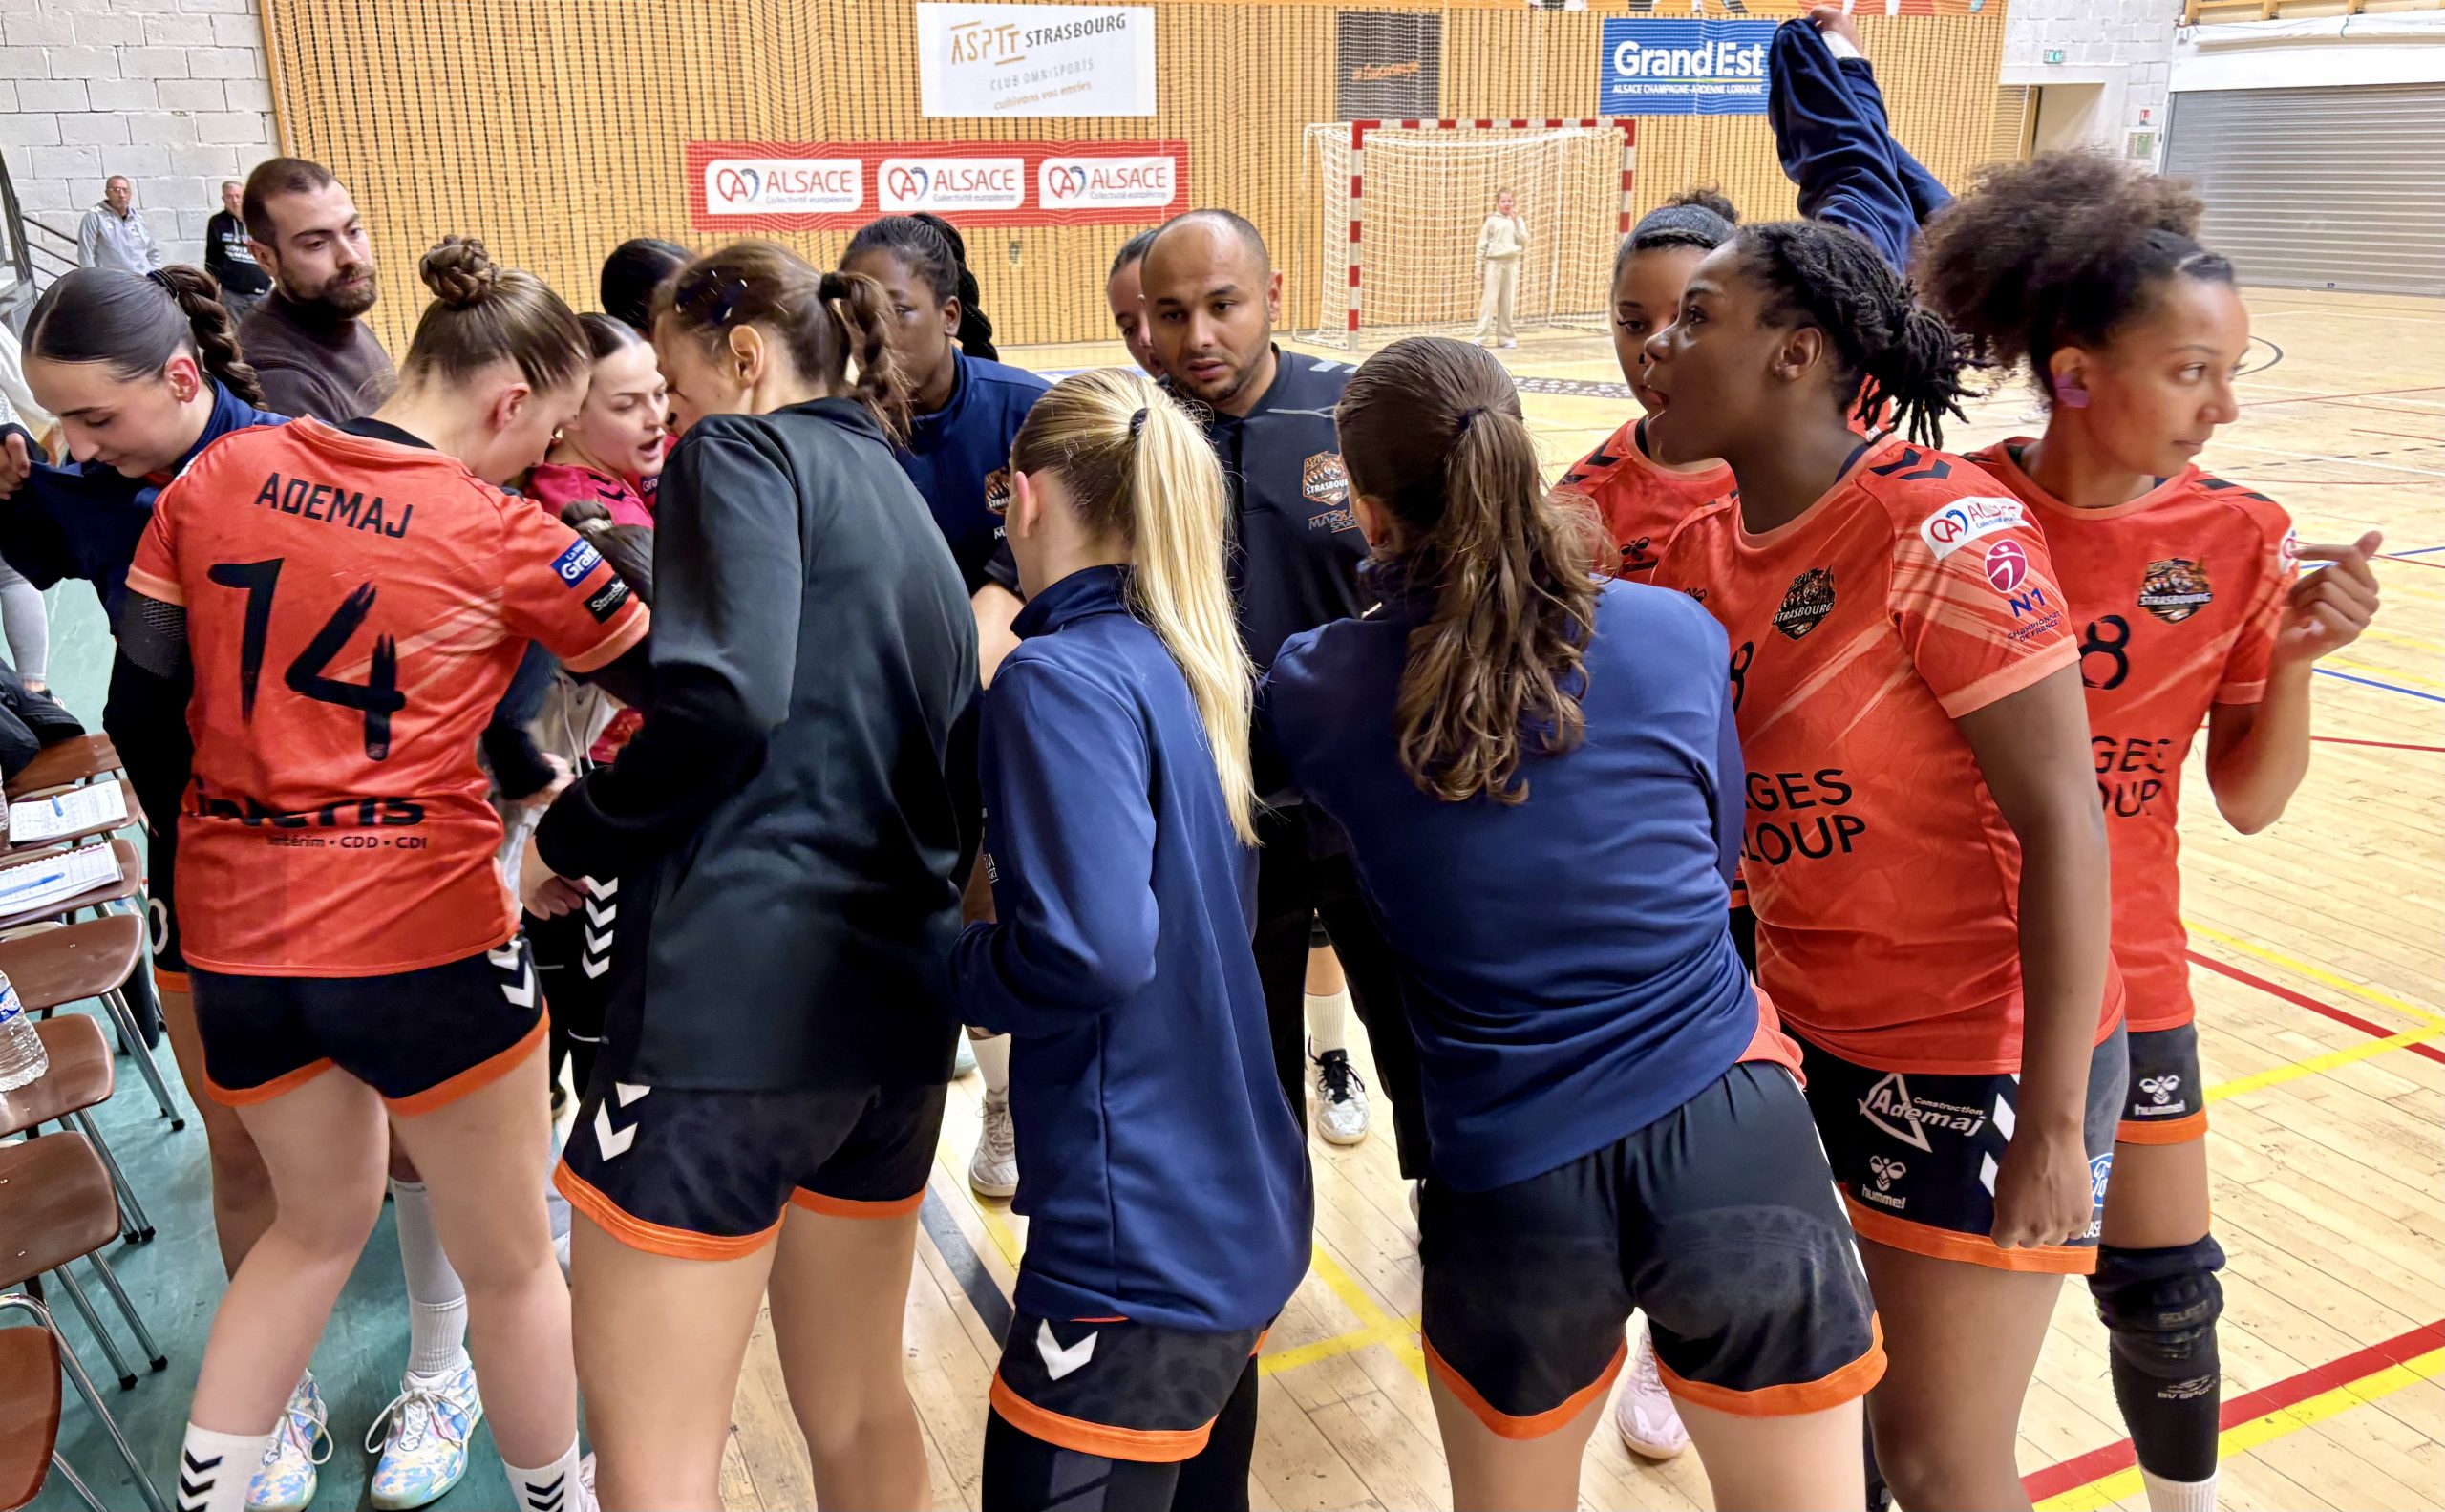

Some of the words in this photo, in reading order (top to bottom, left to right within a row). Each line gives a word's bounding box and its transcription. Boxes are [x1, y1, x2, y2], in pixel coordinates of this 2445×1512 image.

[1026, 13, 1126, 48] STRASBOURG
[990, 75, 1020, 91] CLUB
[1023, 58, 1095, 85] OMNISPORTS
[1612, 84, 1643, 95] ALSACE
[1727, 84, 1763, 95] LORRAINE
[766, 170, 853, 193] ALSACE
[933, 168, 1015, 191] ALSACE
[1091, 166, 1167, 189] ALSACE
[254, 471, 415, 539] ADEMAJ
[1774, 602, 1834, 624] STRASBOURG
[207, 558, 406, 762] 14
[1745, 768, 1853, 812] GES
[340, 836, 378, 848] CDD
[395, 836, 428, 849] CDI
[1740, 814, 1866, 866] LOUP
[1870, 1088, 1987, 1137] Ademaj
[1913, 1097, 1984, 1116] Construction
[2134, 1099, 2186, 1116] hummel
[1862, 1183, 1907, 1210] hummel
